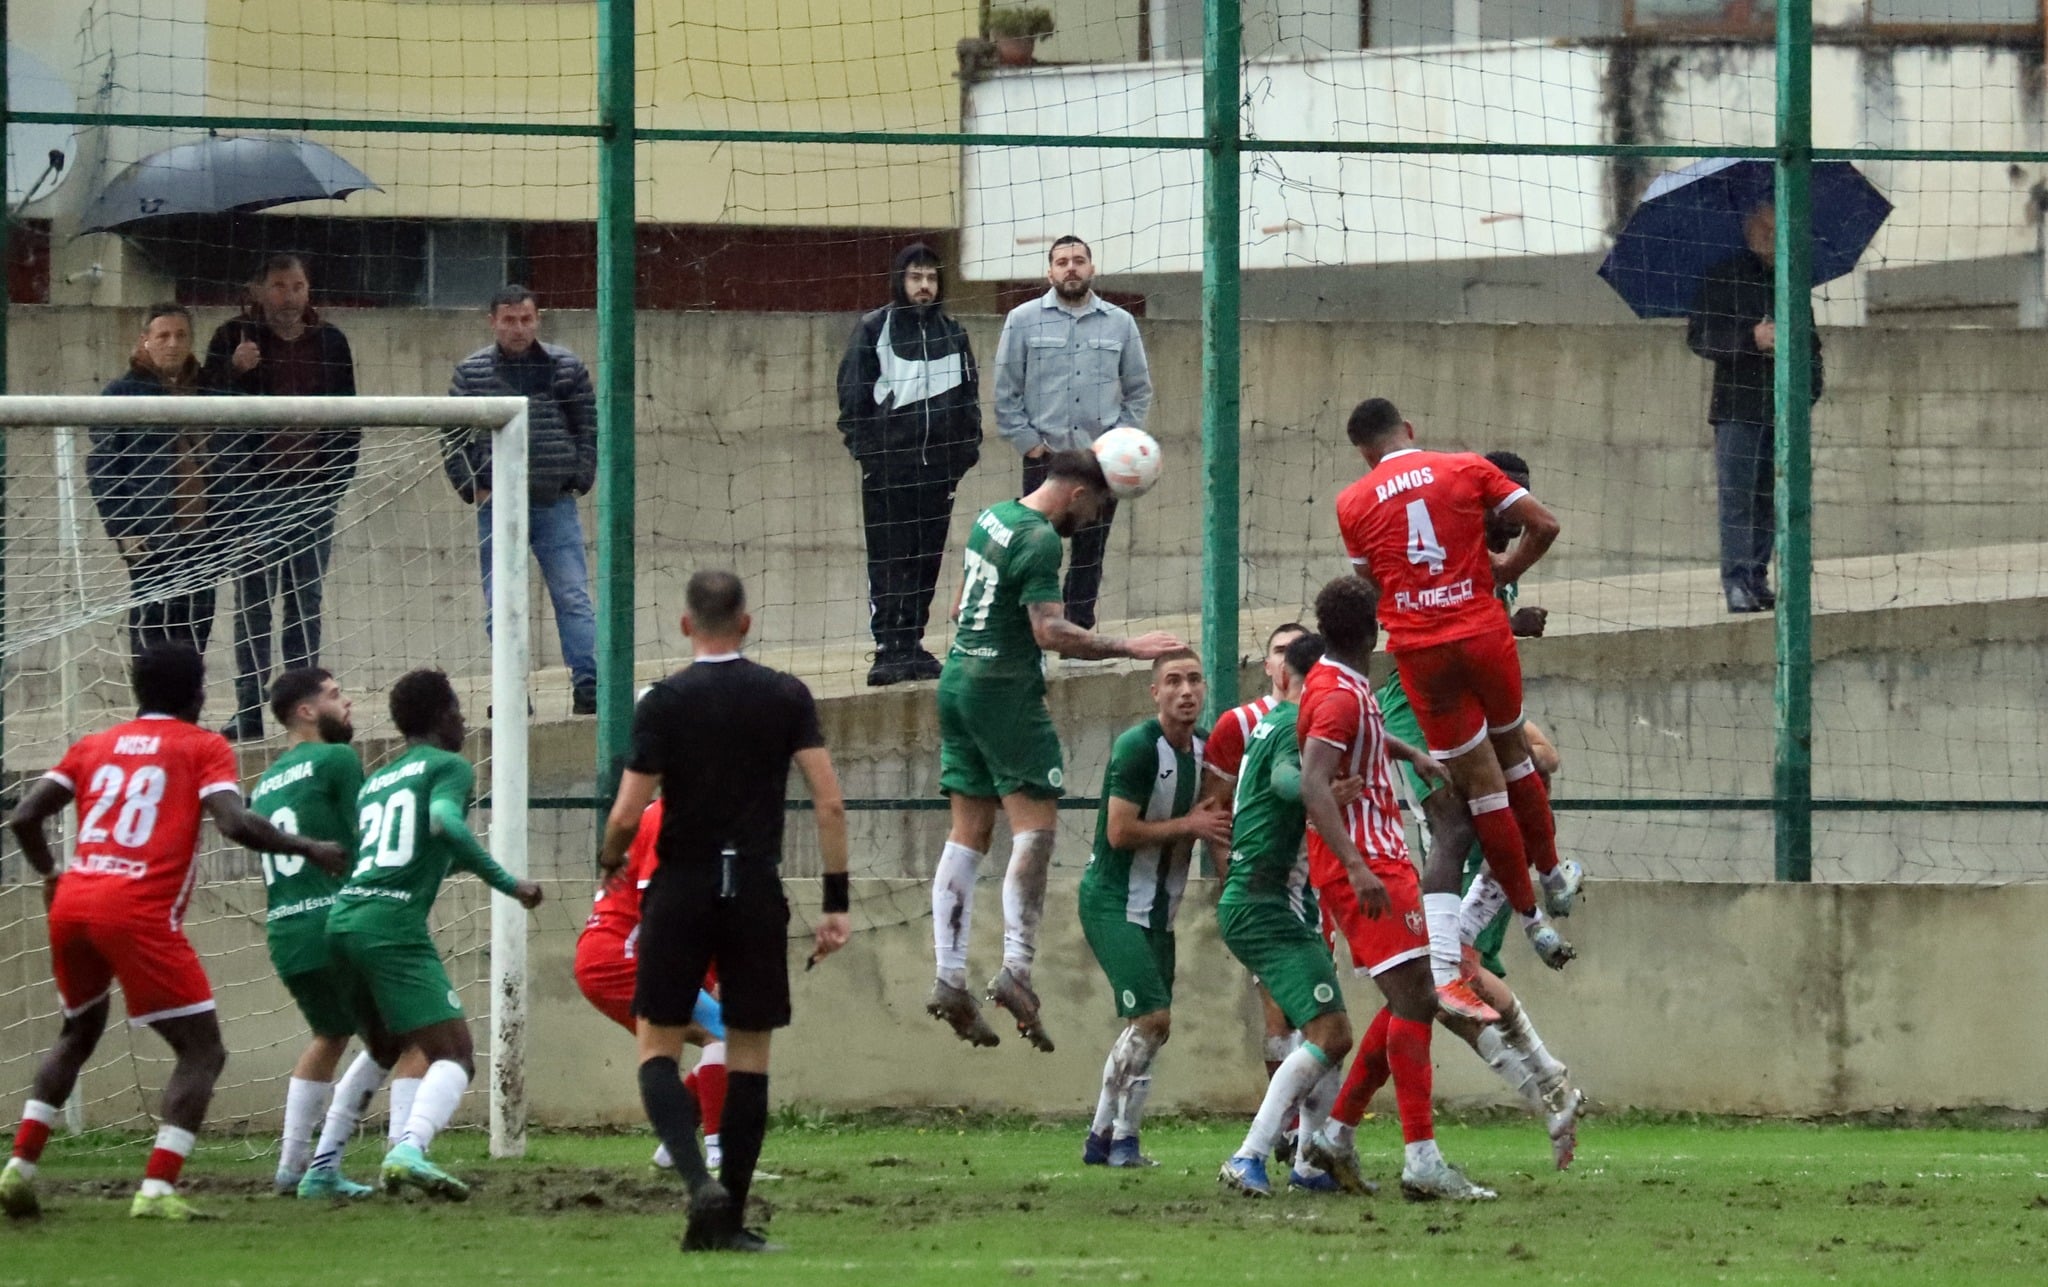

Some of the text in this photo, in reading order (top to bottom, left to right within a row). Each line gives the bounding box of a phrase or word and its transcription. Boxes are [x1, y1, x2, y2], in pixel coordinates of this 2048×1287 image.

[1375, 466, 1435, 503] RAMOS
[1406, 498, 1447, 576] 4
[79, 764, 166, 848] 28
[352, 787, 416, 877] 20
[305, 892, 337, 910] Estat
